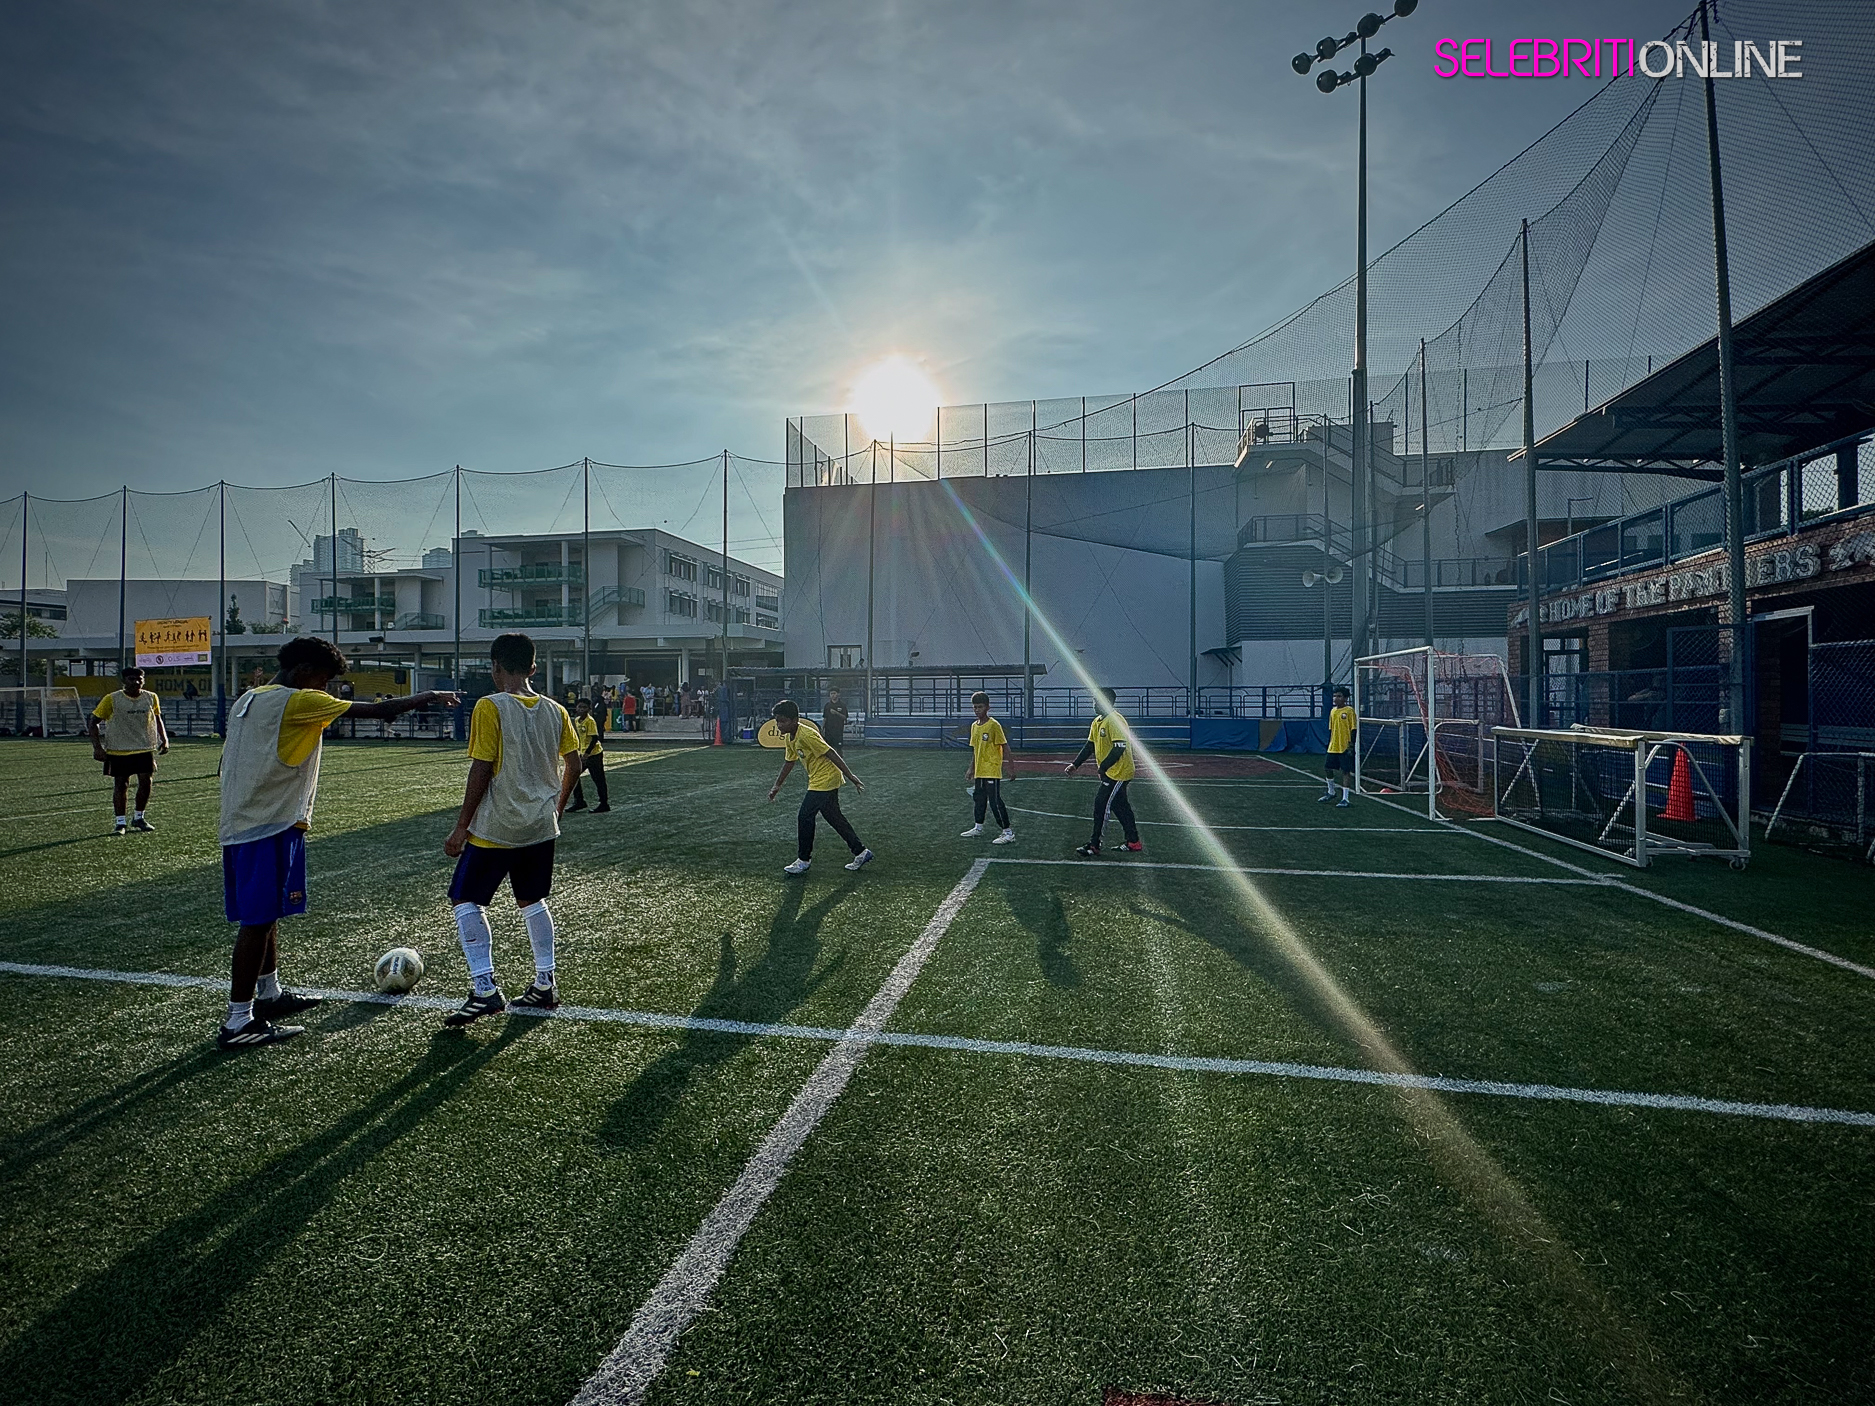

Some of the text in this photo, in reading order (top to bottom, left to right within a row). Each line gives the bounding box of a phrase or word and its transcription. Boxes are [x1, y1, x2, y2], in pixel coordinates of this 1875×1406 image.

[1549, 594, 1594, 622] HOME
[1595, 589, 1620, 615] OF
[1621, 575, 1666, 609] THE
